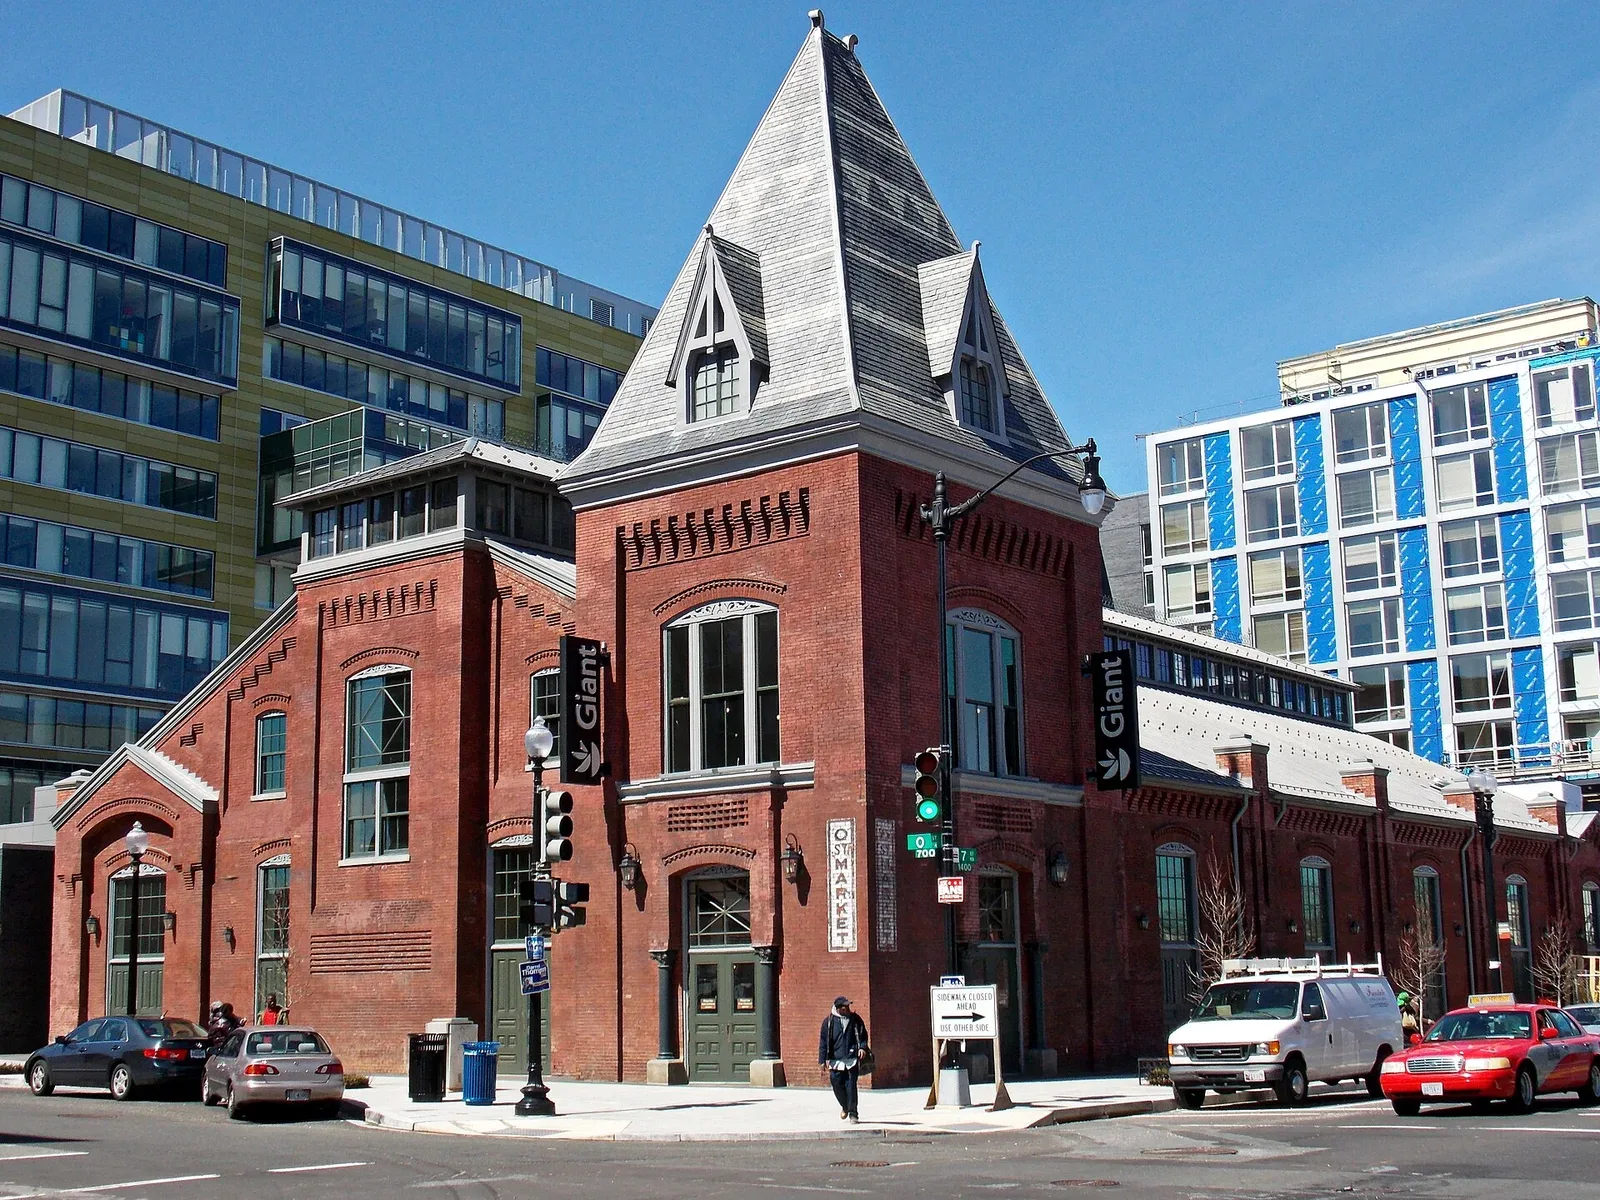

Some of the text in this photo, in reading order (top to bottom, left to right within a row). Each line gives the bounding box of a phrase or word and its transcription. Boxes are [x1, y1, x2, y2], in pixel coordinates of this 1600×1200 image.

[575, 645, 597, 730] Giant
[1100, 656, 1125, 738] Giant
[916, 849, 936, 858] 700
[961, 850, 967, 862] 7
[958, 863, 972, 872] 1400
[835, 859, 848, 944] MARKET
[937, 992, 993, 1001] SIDEWALK CLOSED
[956, 1002, 977, 1011] AHEAD
[940, 1023, 989, 1032] USE OTHER SIDE
